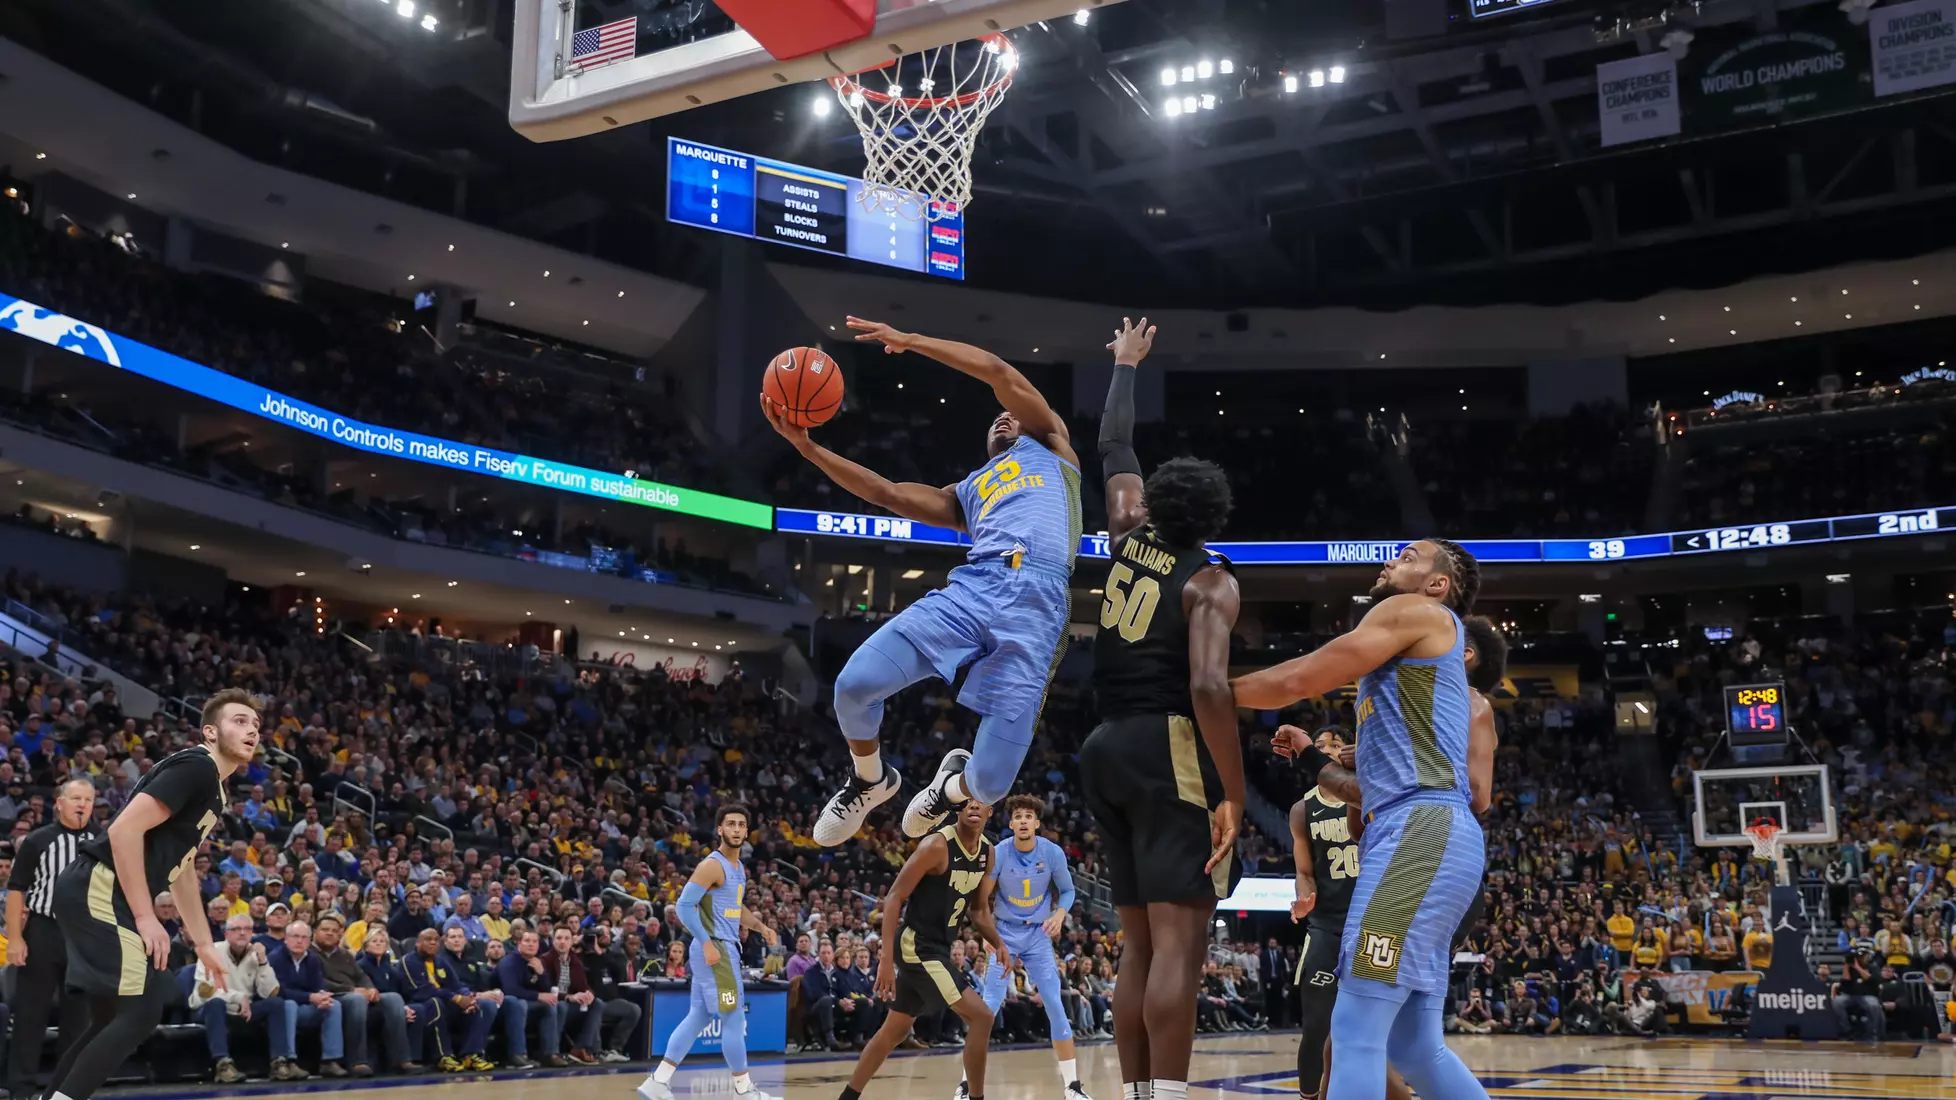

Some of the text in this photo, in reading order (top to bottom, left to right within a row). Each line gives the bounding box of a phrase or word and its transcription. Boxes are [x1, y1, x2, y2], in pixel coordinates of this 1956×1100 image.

[1887, 8, 1942, 33] DIVISION
[1879, 22, 1954, 50] CHAMPIONS
[1602, 69, 1672, 96] CONFERENCE
[1701, 70, 1753, 95] WORLD
[1757, 52, 1845, 84] CHAMPIONS
[1606, 85, 1670, 109] CHAMPIONS
[676, 144, 747, 169] MARQUETTE
[712, 184, 718, 194] 1
[783, 184, 819, 199] ASSISTS
[784, 199, 818, 213] STEALS
[784, 213, 818, 228] BLOCKS
[774, 225, 827, 244] TURNOVERS
[260, 393, 679, 506] Johnson Controls makes Fiserv Forum sustainable
[973, 453, 1021, 501] 25
[816, 514, 911, 538] 9:41 PM
[1878, 510, 1938, 533] 2nd
[1588, 541, 1625, 559] 39
[1705, 525, 1791, 550] 12:48
[1122, 536, 1176, 576] WILLIAMS
[1327, 544, 1398, 562] MARQUETTE
[1100, 561, 1161, 643] 50
[1738, 688, 1777, 705] 12:48
[1750, 704, 1776, 730] 15
[1310, 816, 1351, 843] PURD
[1327, 845, 1360, 880] 20
[1022, 879, 1031, 897] 1
[947, 897, 966, 927] 2
[1361, 931, 1398, 969] MU
[1310, 970, 1335, 987] P
[721, 991, 735, 1005] MU
[1758, 988, 1826, 1014] meijer
